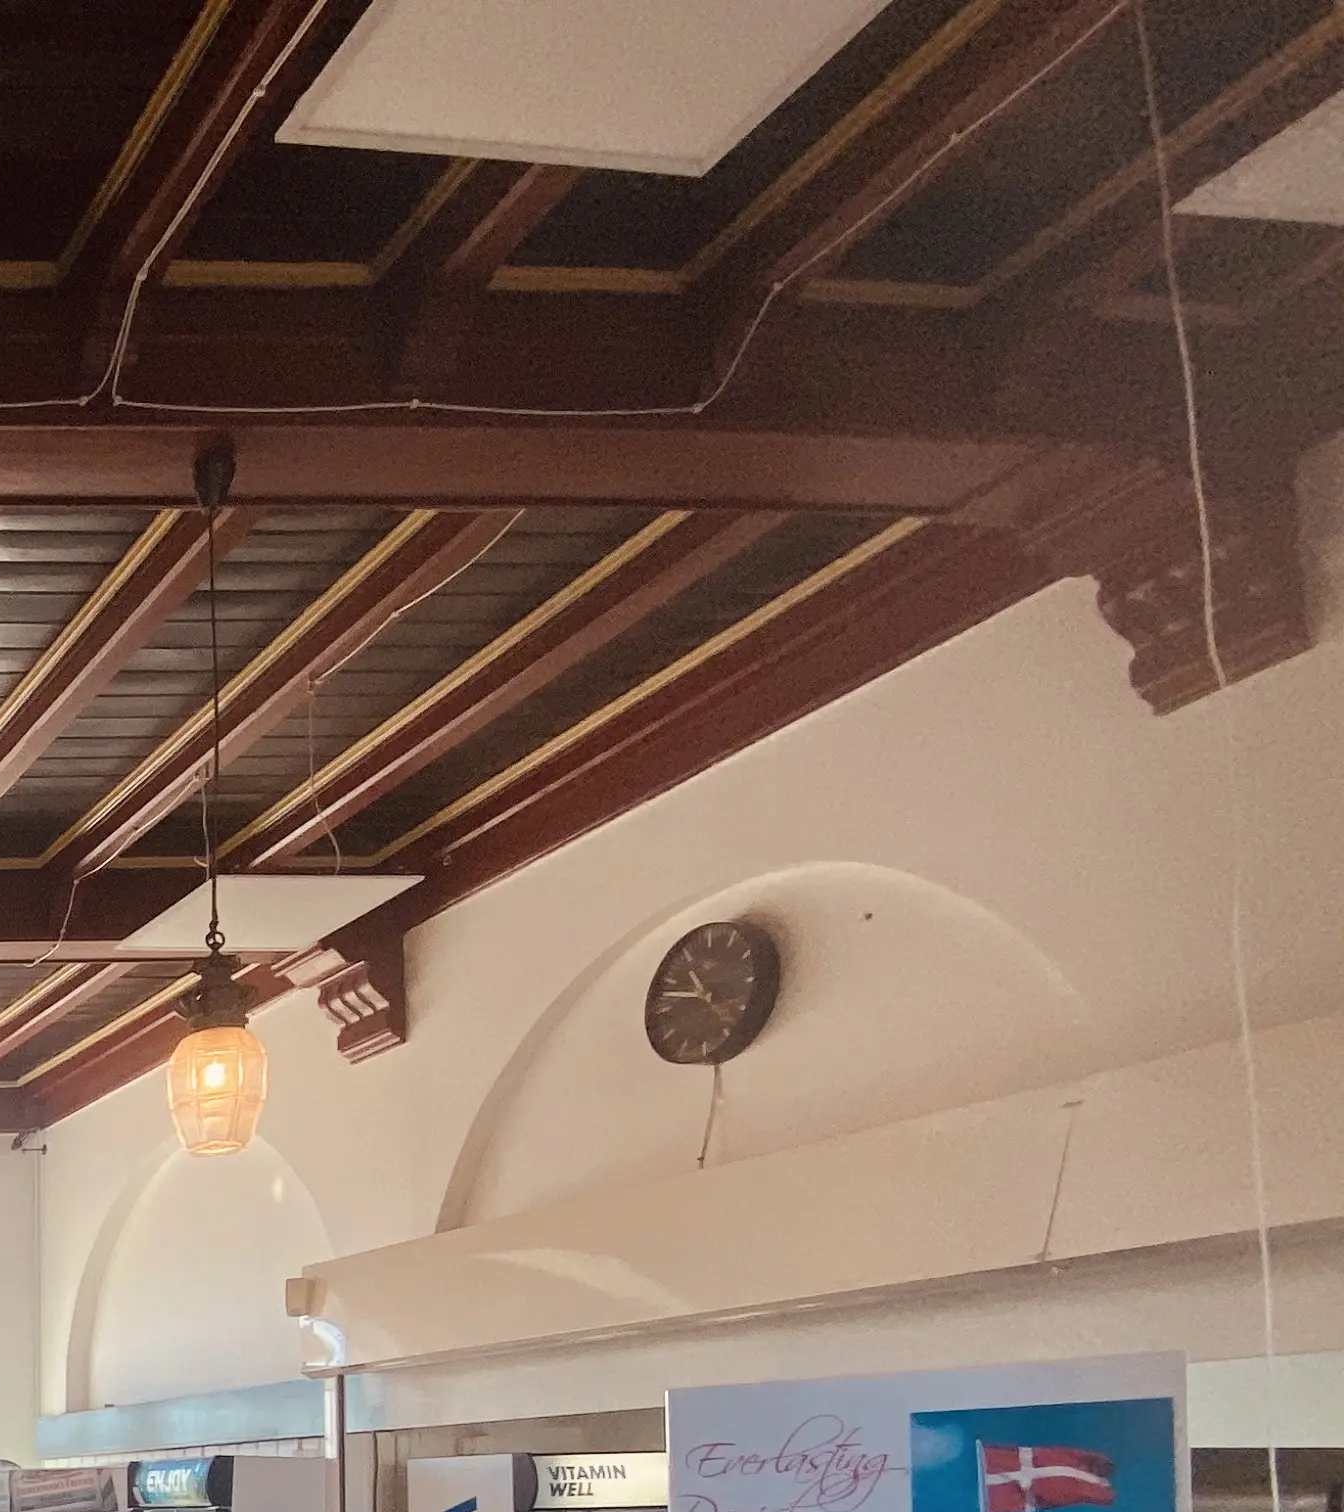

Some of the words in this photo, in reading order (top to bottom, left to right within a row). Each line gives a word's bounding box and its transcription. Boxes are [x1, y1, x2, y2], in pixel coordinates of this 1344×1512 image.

[548, 1465, 627, 1480] VITAMIN
[147, 1469, 192, 1492] ENJOY
[549, 1482, 594, 1497] WELL
